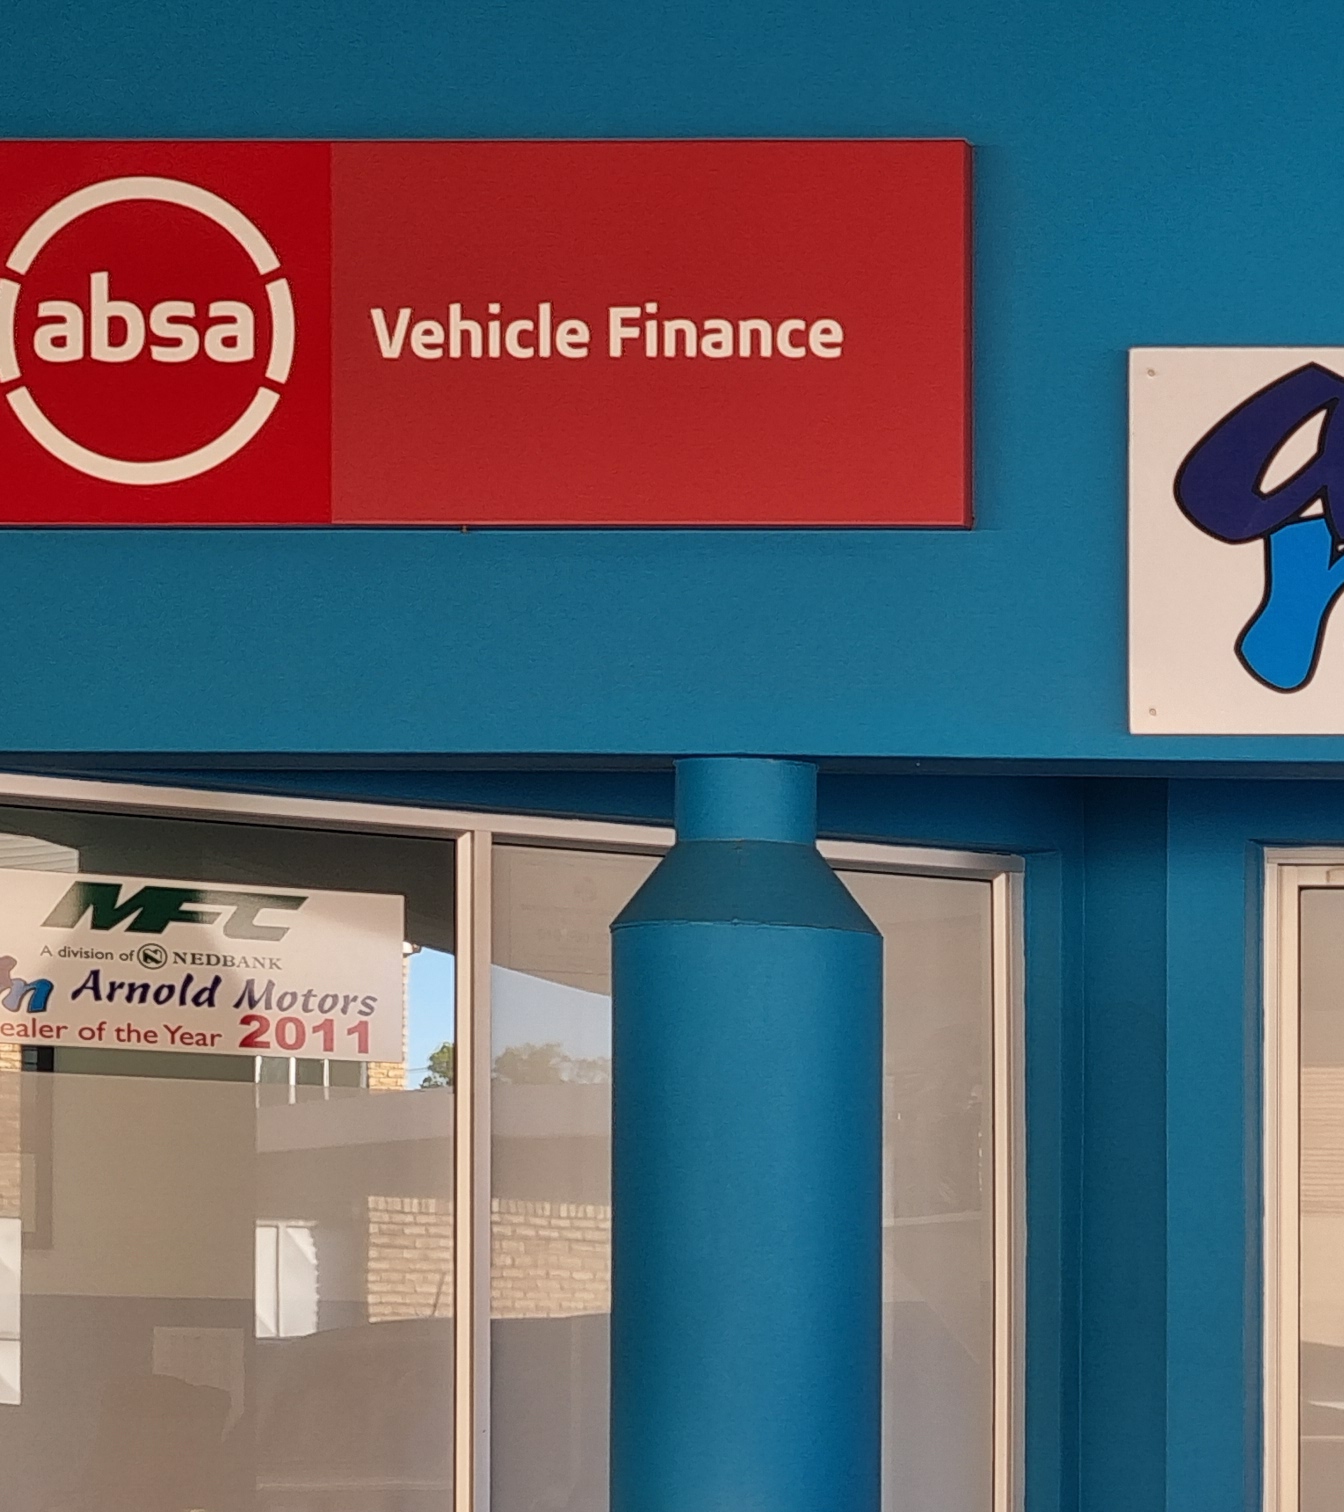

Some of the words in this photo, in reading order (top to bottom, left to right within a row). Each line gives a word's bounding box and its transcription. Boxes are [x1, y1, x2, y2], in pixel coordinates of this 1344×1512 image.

[33, 271, 257, 364] absa
[370, 302, 590, 359] Vehicle
[609, 302, 845, 358] Finance
[40, 881, 309, 941] MFC
[40, 945, 53, 957] A
[58, 946, 114, 959] division
[119, 949, 136, 961] of
[172, 951, 282, 970] NEDBANK
[71, 969, 222, 1008] Arnold
[232, 978, 378, 1017] Motors
[0, 1017, 68, 1039] ealer
[78, 1021, 109, 1041] of
[114, 1022, 158, 1044] the
[163, 1025, 223, 1047] Year
[238, 1014, 371, 1055] 2011
